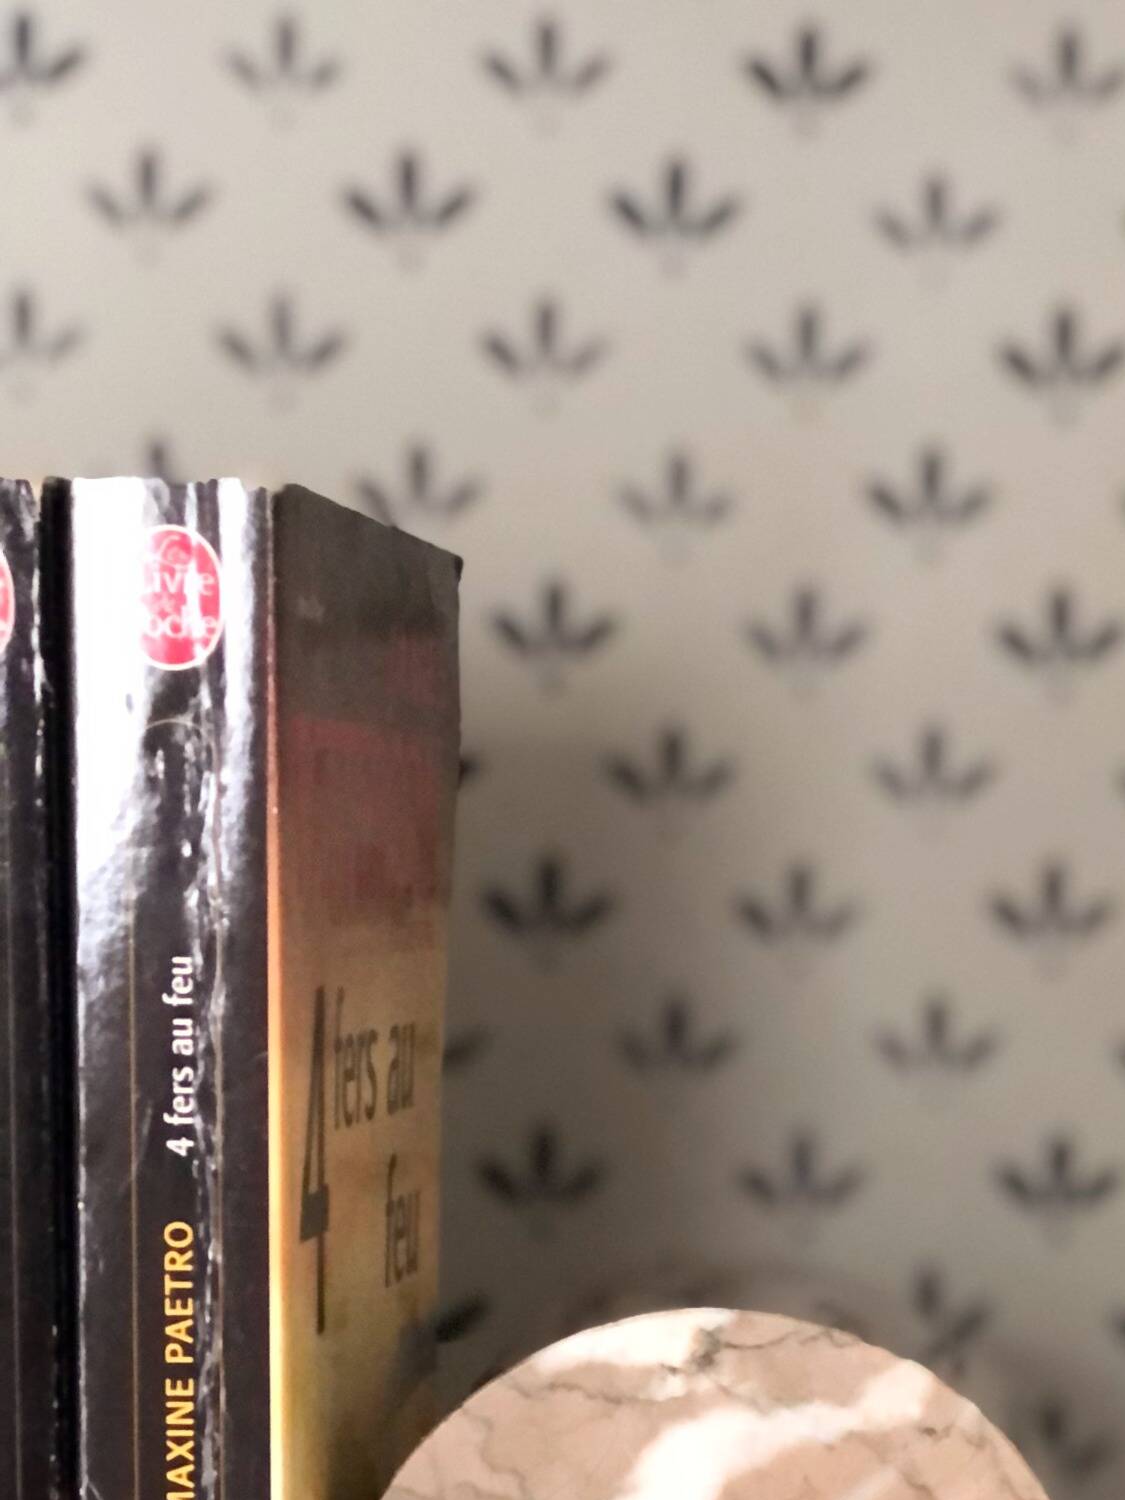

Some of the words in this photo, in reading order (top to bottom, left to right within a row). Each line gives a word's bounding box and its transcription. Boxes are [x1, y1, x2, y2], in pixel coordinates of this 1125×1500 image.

[161, 956, 194, 1007] feu
[172, 1017, 194, 1056] au
[163, 1066, 195, 1126] fers
[166, 1136, 195, 1157] 4
[163, 1220, 195, 1365] PAETRO
